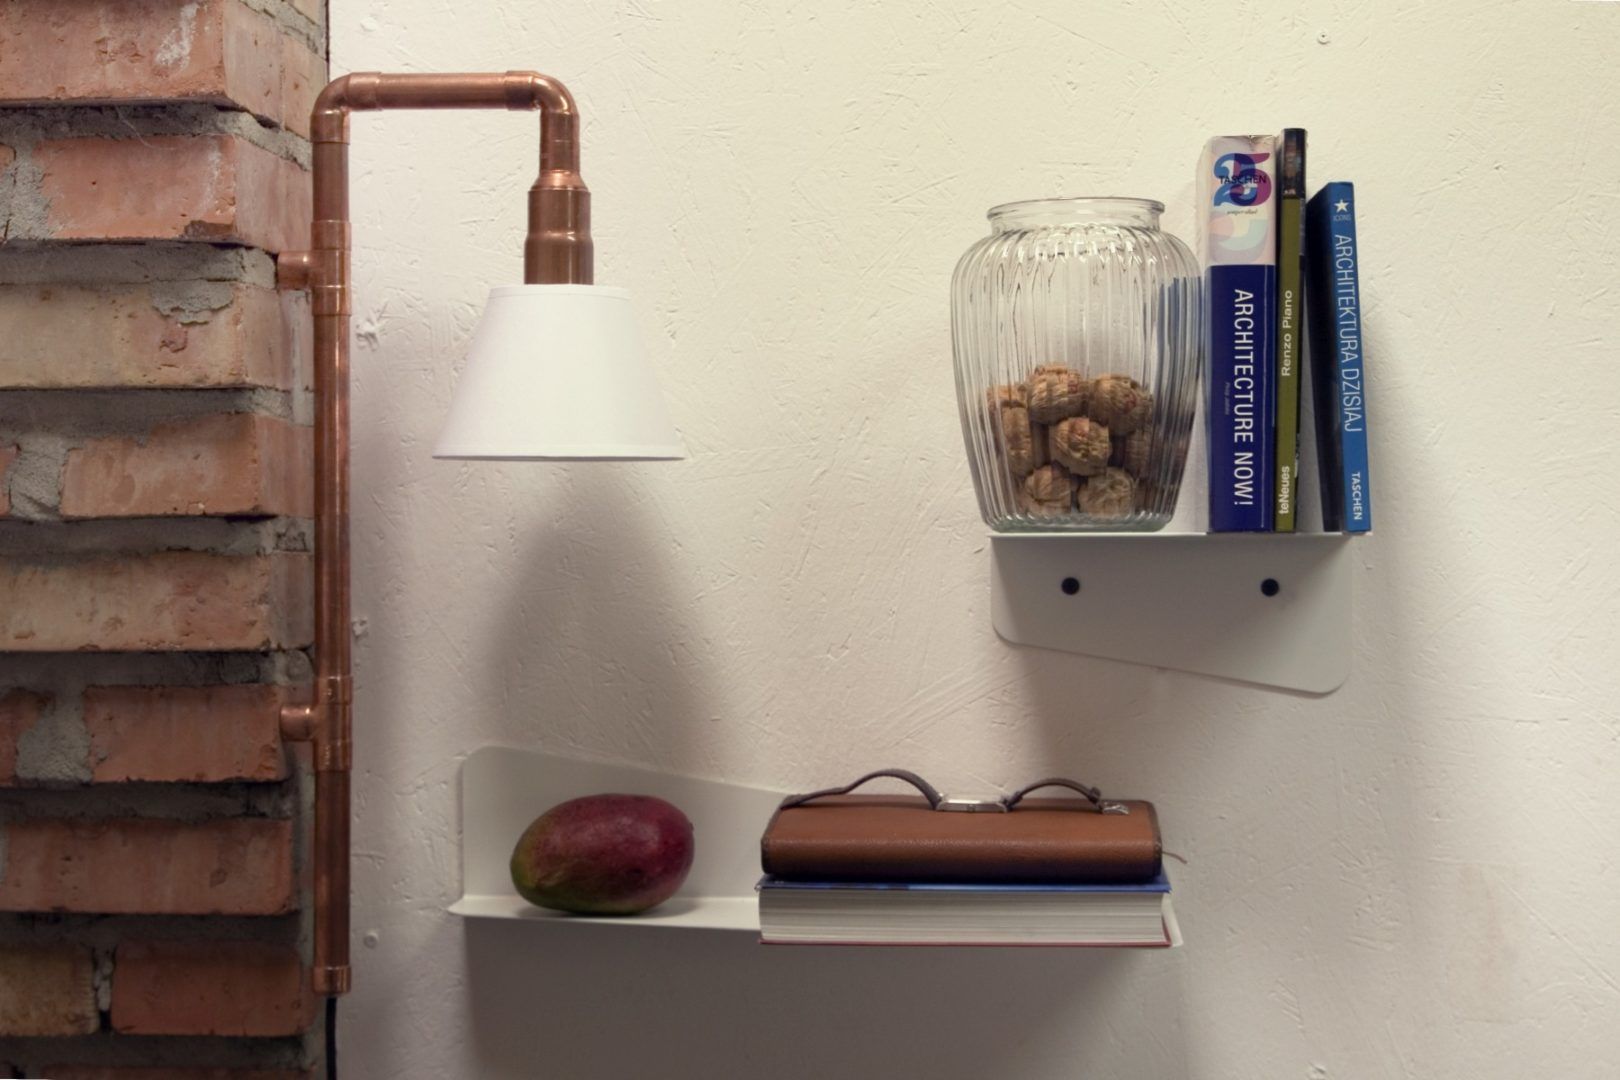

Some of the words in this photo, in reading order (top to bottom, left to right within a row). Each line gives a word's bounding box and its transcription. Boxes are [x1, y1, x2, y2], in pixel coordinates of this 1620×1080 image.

[1218, 175, 1267, 185] TASCHEN
[1282, 290, 1293, 329] Piano
[1334, 233, 1359, 363] ARCHITEKTURA
[1234, 289, 1254, 443] ARCHITECTURE
[1281, 333, 1292, 377] Renzo
[1341, 368, 1363, 433] DZISIAJ
[1234, 452, 1254, 506] NOW!
[1278, 465, 1290, 515] teNeues
[1351, 471, 1363, 521] TASCHEN
